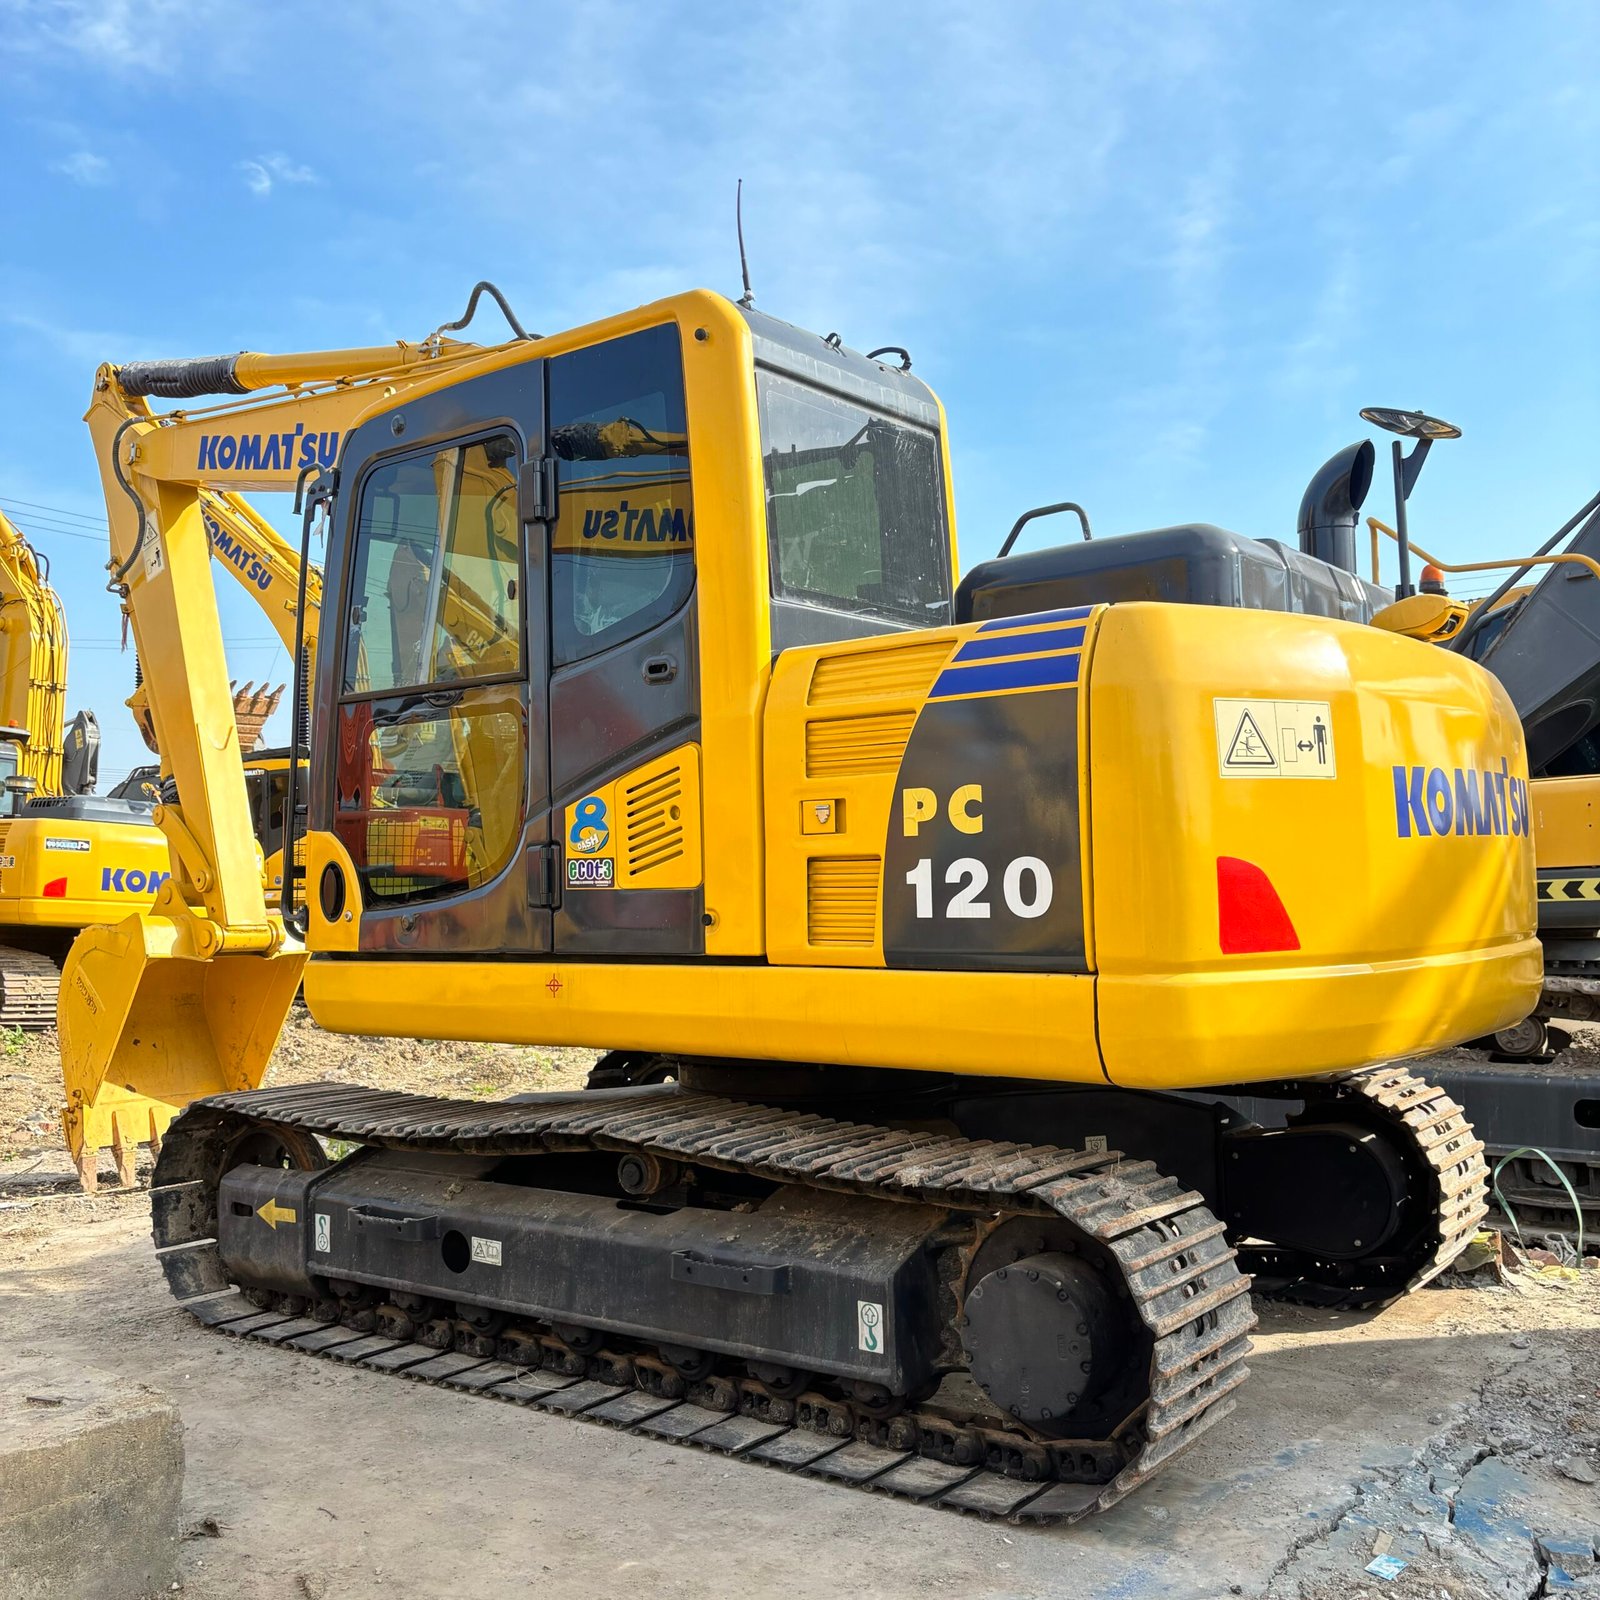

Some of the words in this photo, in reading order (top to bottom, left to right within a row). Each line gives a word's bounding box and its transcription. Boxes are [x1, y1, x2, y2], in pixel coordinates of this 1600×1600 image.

[198, 423, 339, 470] KOMATSU
[903, 784, 983, 837] PC
[1393, 757, 1529, 838] KOMATSU
[570, 796, 609, 854] 8
[577, 833, 599, 851] DASH
[568, 859, 613, 880] ecot3
[906, 856, 1053, 918] 120
